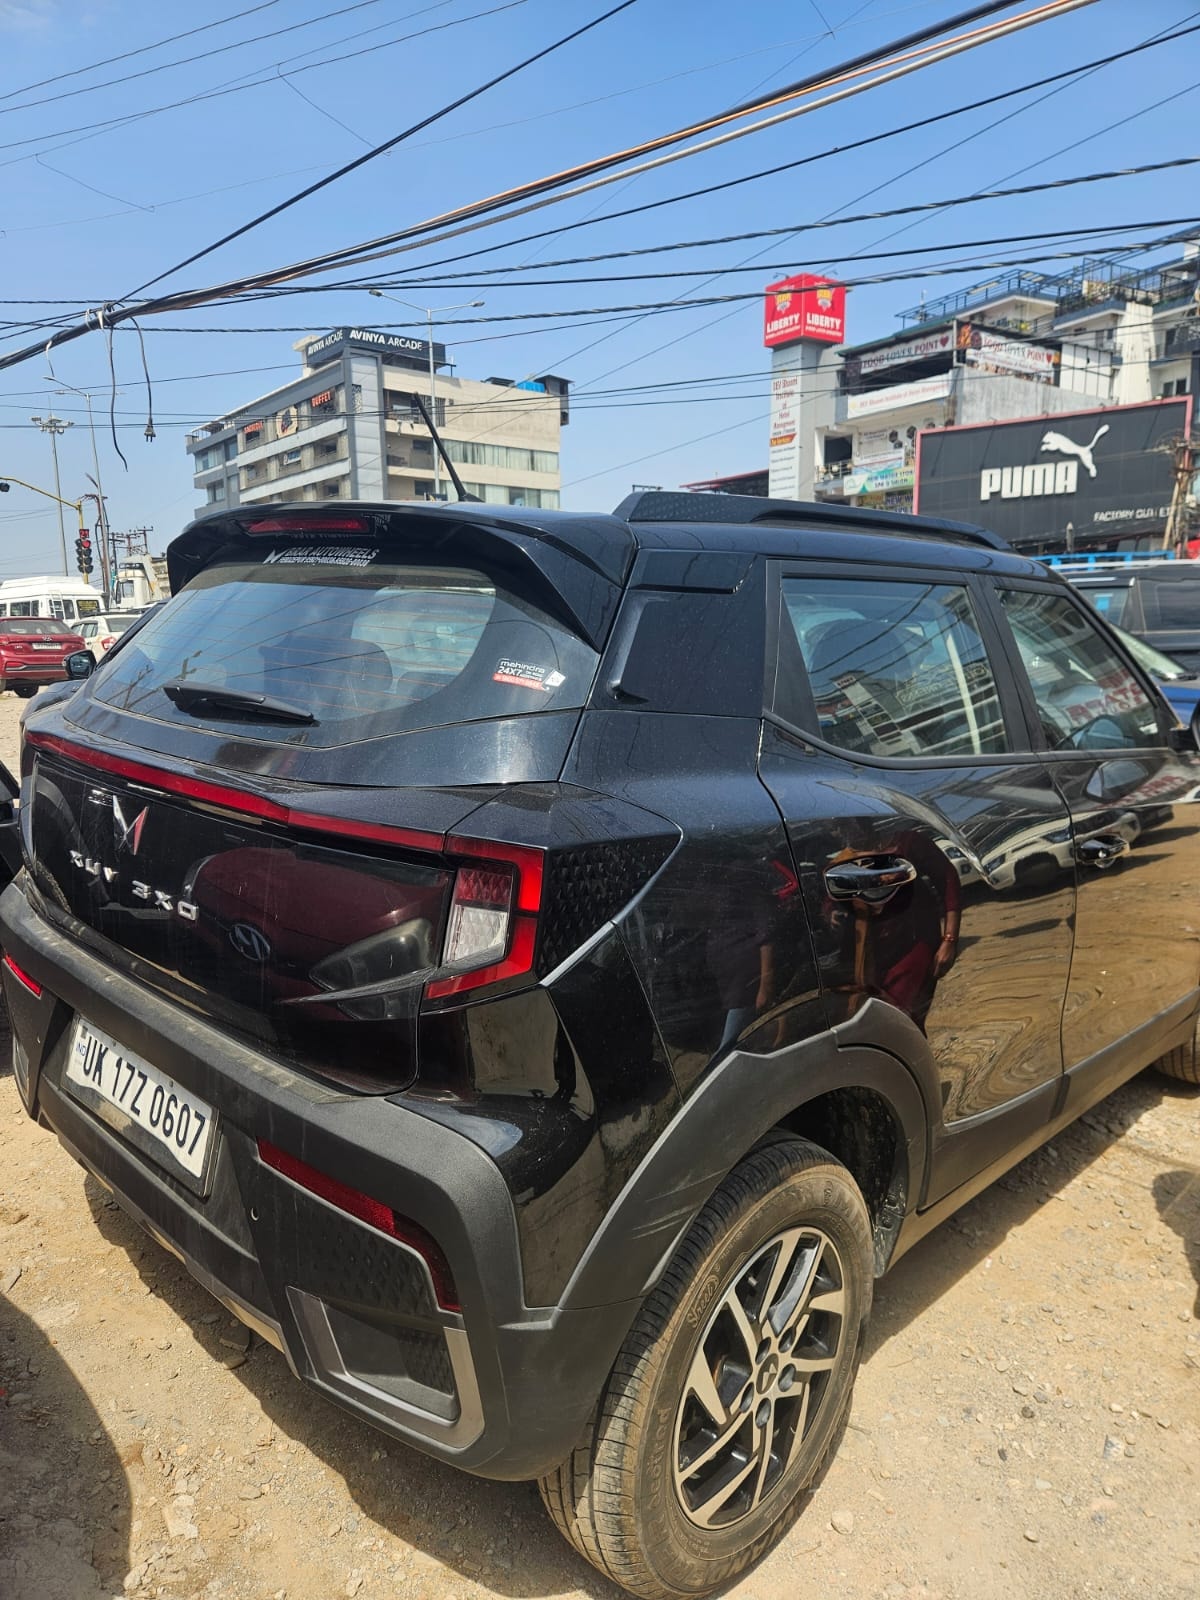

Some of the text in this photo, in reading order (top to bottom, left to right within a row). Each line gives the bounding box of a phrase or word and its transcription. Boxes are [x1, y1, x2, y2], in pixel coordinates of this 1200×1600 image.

[767, 312, 800, 334] LIBERTY
[806, 312, 841, 330] LIBERTY
[308, 330, 343, 356] AVINYA ARCADE
[349, 329, 423, 351] AVINYA ARCADE
[914, 339, 938, 354] POINT
[1026, 348, 1046, 361] POINT
[980, 461, 1078, 501] PUMA
[1093, 510, 1134, 522] FACTORY
[309, 546, 379, 559] AUTOWHEELS
[501, 661, 545, 673] mahindra
[69, 850, 199, 921] XUV 3XO
[83, 1036, 206, 1156] UK 17Z 0607
